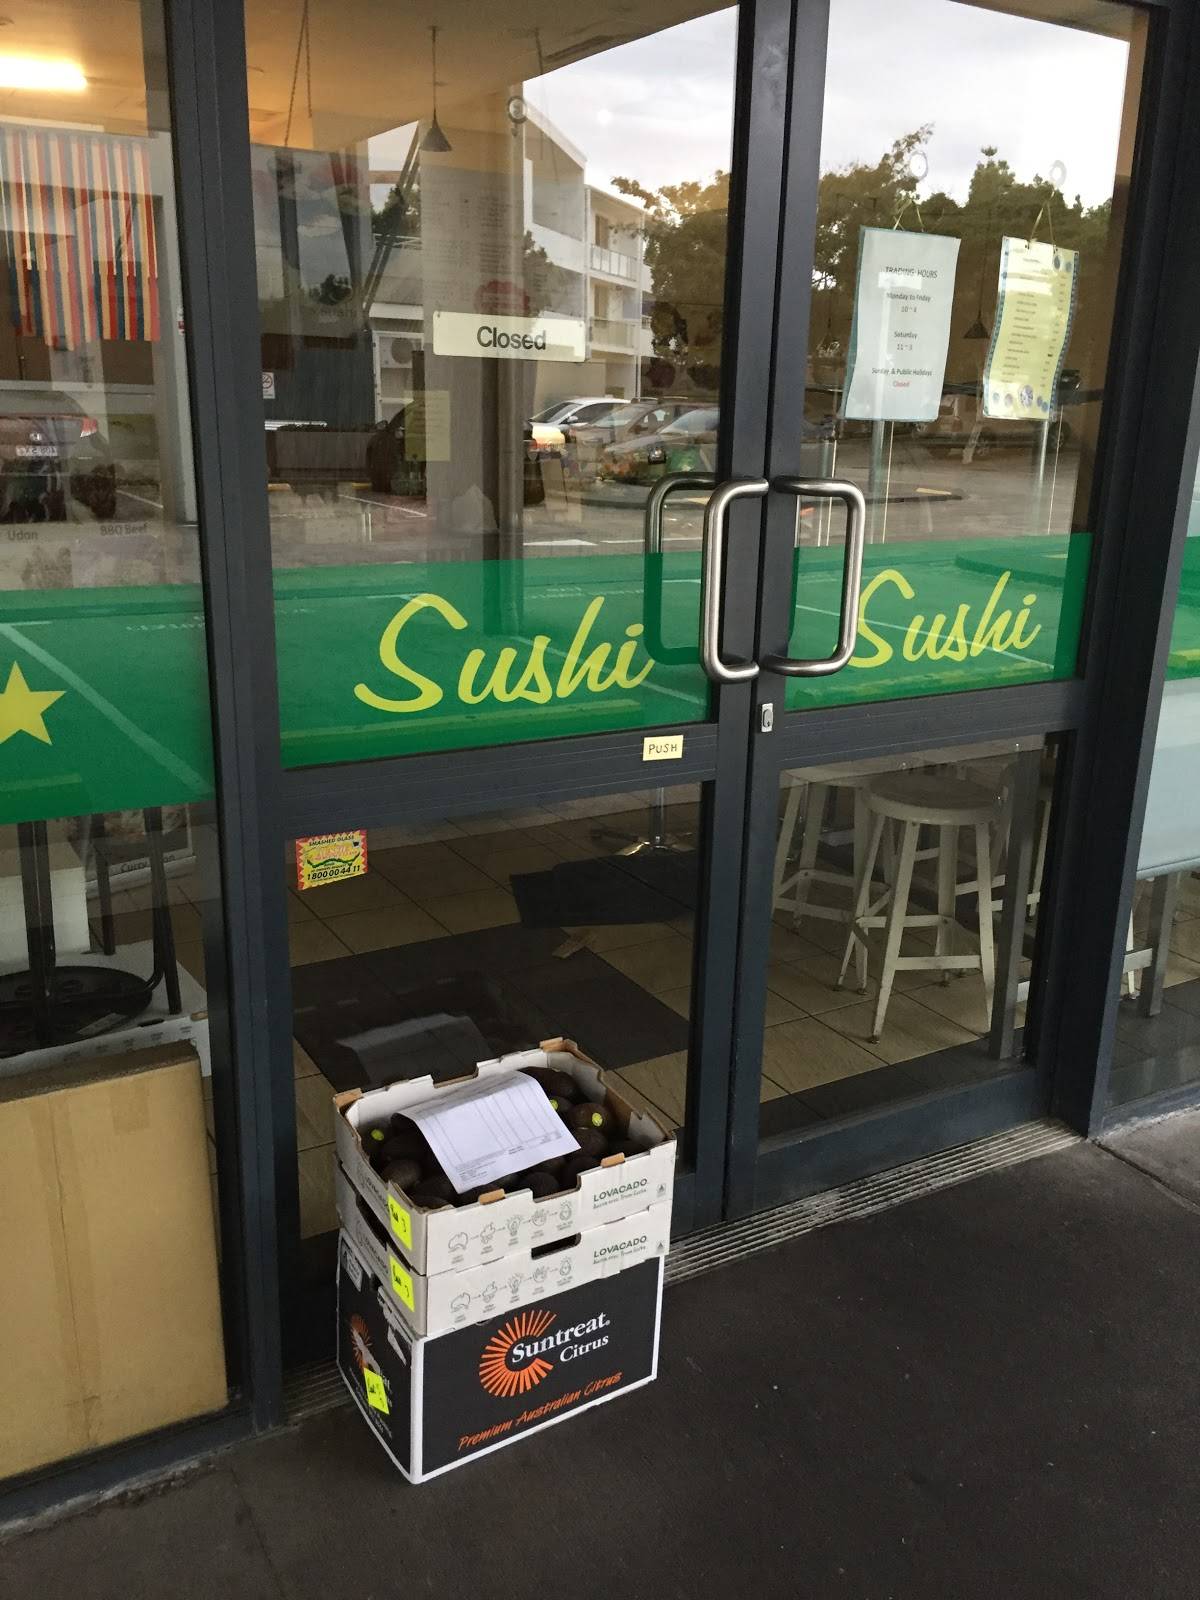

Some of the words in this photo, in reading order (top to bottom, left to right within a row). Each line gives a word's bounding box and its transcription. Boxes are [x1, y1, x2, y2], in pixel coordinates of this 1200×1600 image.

[917, 268, 938, 279] HOURS
[916, 294, 931, 303] Friday
[476, 325, 547, 351] Closed
[893, 331, 918, 341] Saturday
[896, 368, 912, 376] Public
[7, 530, 39, 541] Udon
[124, 523, 149, 536] Beef
[833, 568, 1042, 669] Sushi
[354, 593, 655, 713] Sushi
[648, 743, 678, 755] PUSH
[593, 1178, 648, 1202] LOVACADO
[593, 1235, 647, 1258] LOVACADO
[511, 1312, 607, 1364] Suntreat
[559, 1335, 609, 1362] Citrus
[457, 1419, 513, 1450] Premium
[515, 1389, 582, 1426] Australian
[583, 1371, 623, 1397] Citrus
